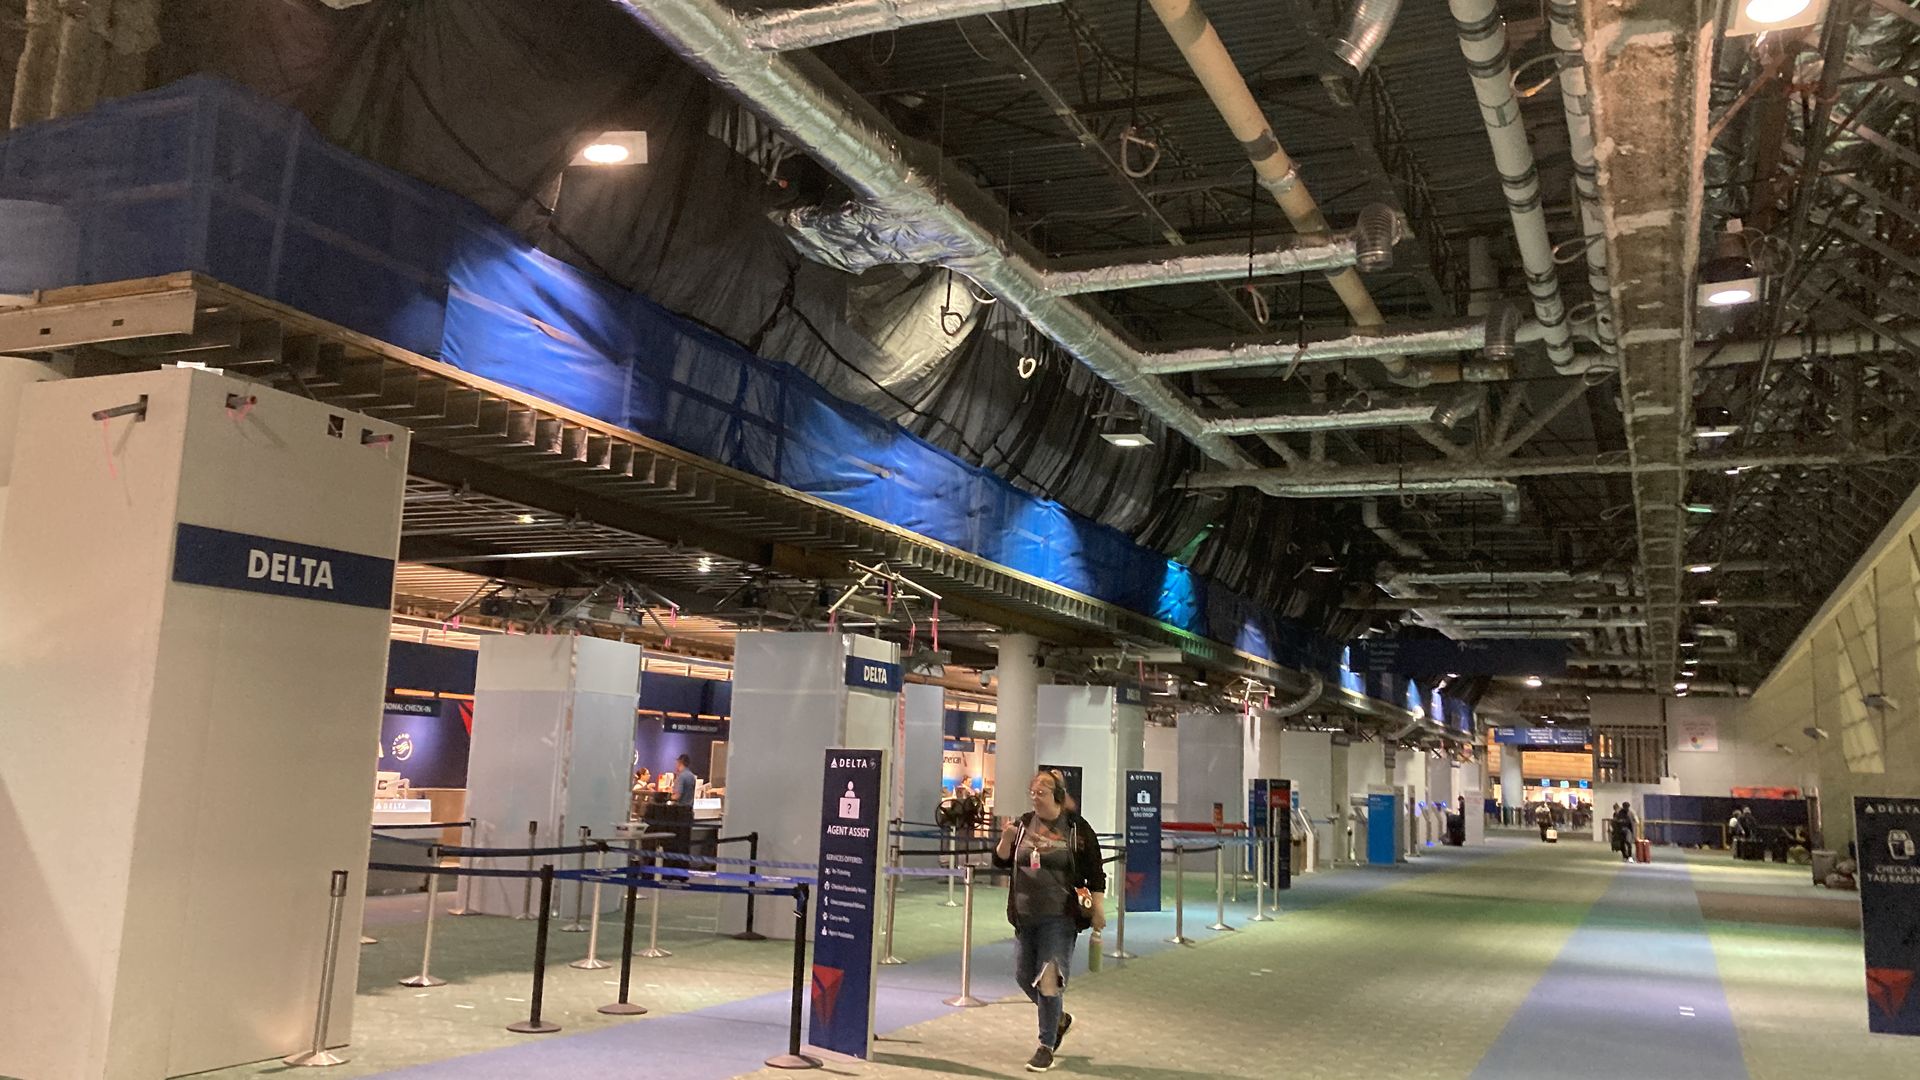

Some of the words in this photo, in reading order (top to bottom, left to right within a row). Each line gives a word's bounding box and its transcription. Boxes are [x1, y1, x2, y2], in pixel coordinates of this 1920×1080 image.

[247, 548, 334, 589] DELTA
[863, 665, 887, 684] DELTA
[839, 758, 868, 769] DELTA
[1877, 804, 1920, 814] DELTA
[827, 825, 848, 837] AGENT
[848, 827, 871, 838] ASSIST
[1867, 873, 1887, 882] TAG
